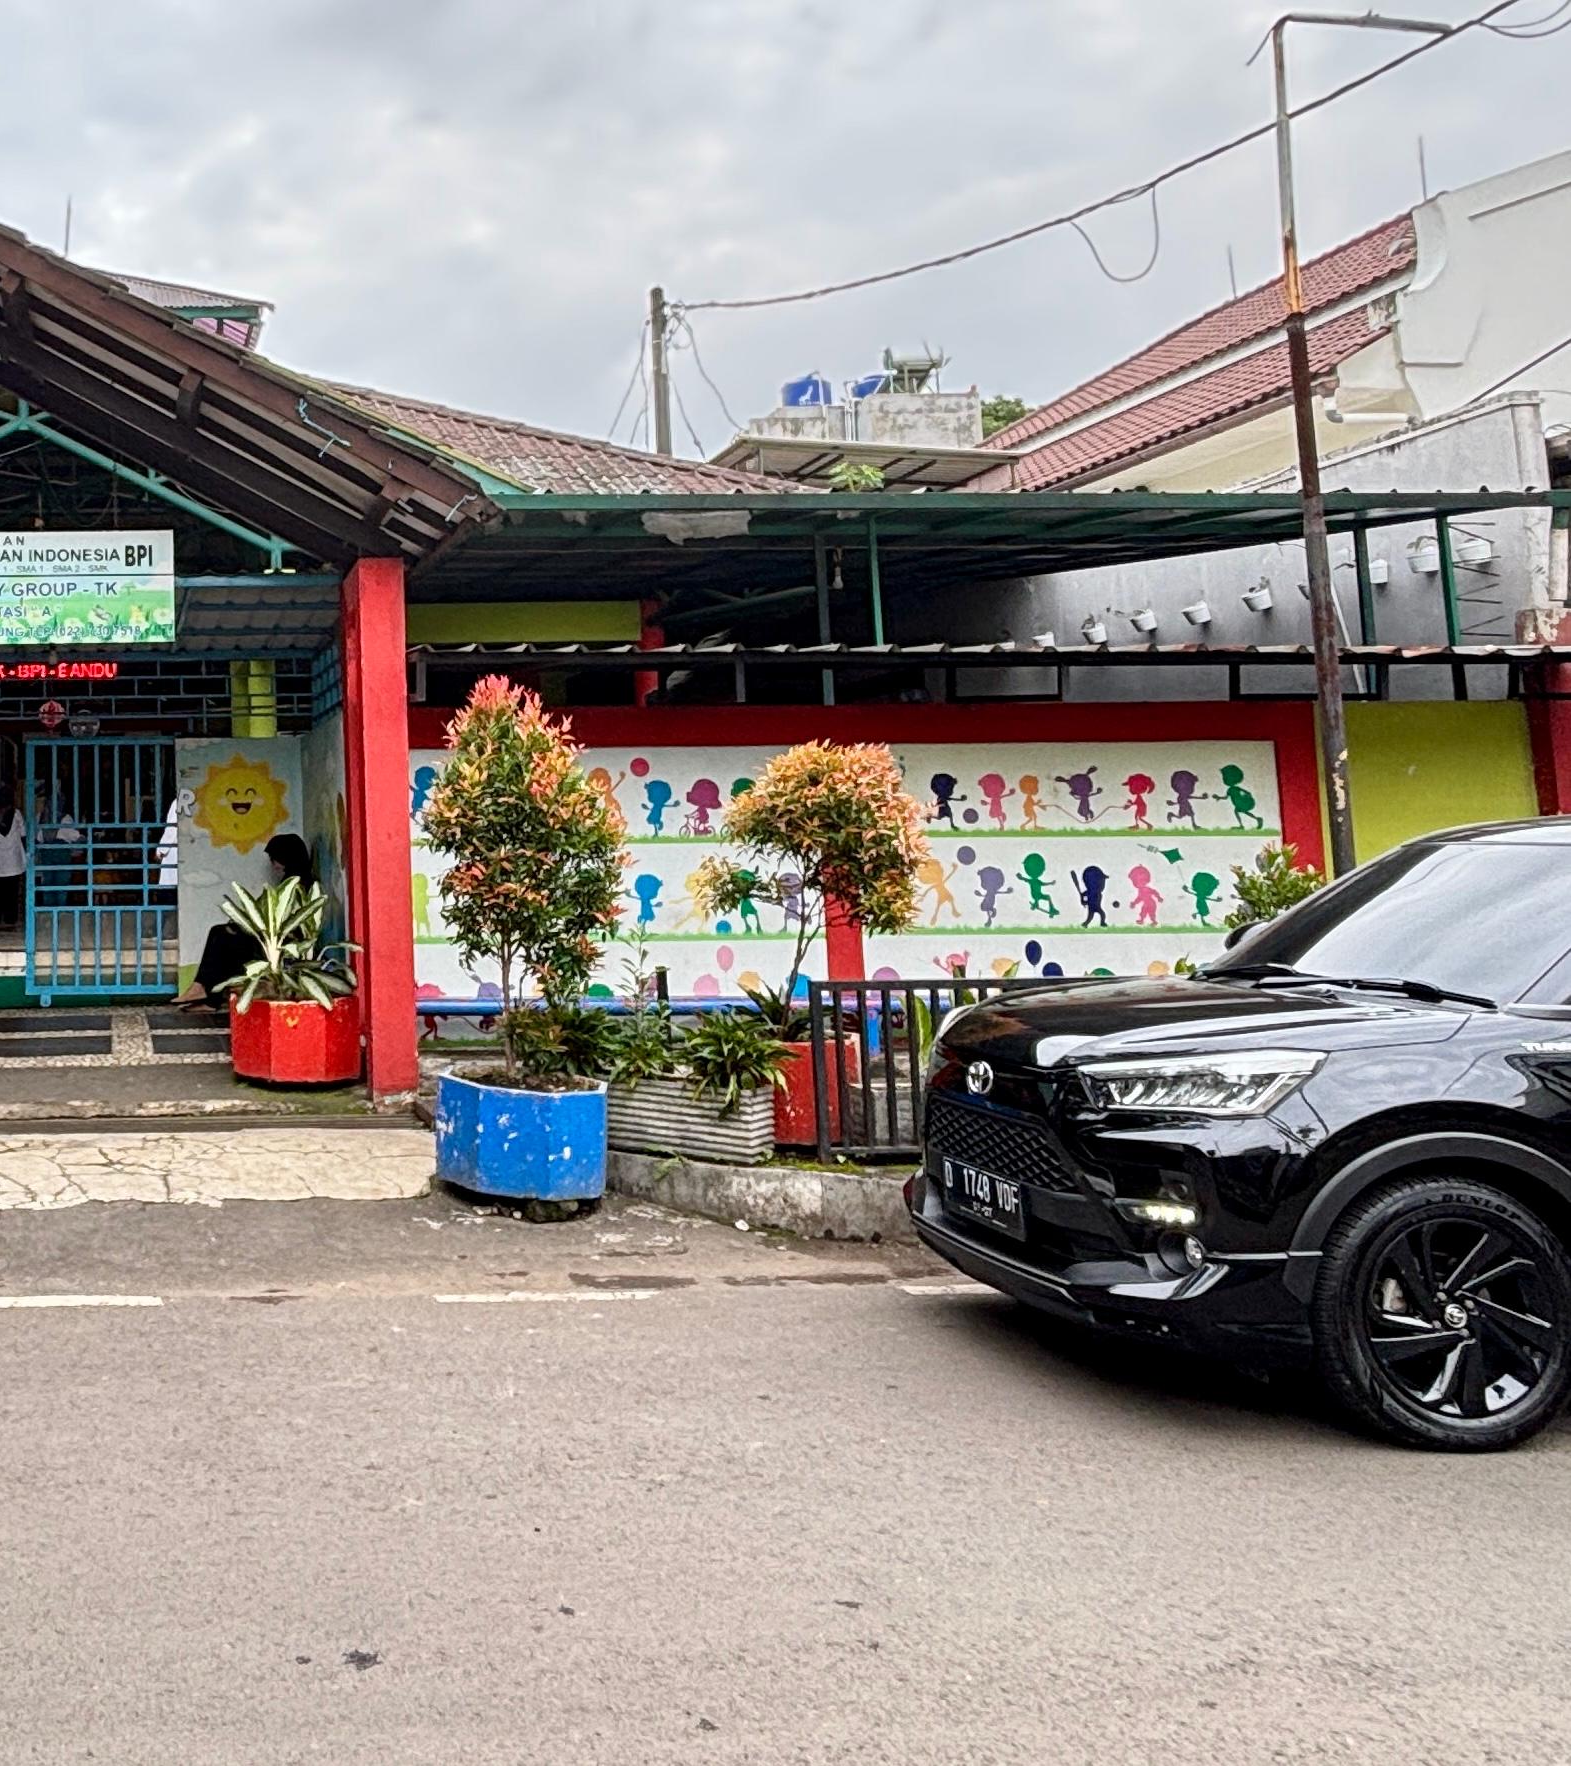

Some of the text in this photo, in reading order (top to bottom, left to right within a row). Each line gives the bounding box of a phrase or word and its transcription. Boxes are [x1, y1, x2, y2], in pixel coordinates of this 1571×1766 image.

[28, 548, 121, 563] INDONESIA
[124, 544, 153, 567] BPI
[11, 582, 78, 596] GROUP
[94, 581, 118, 596] TK
[944, 1160, 1020, 1214] D 1748 VDF
